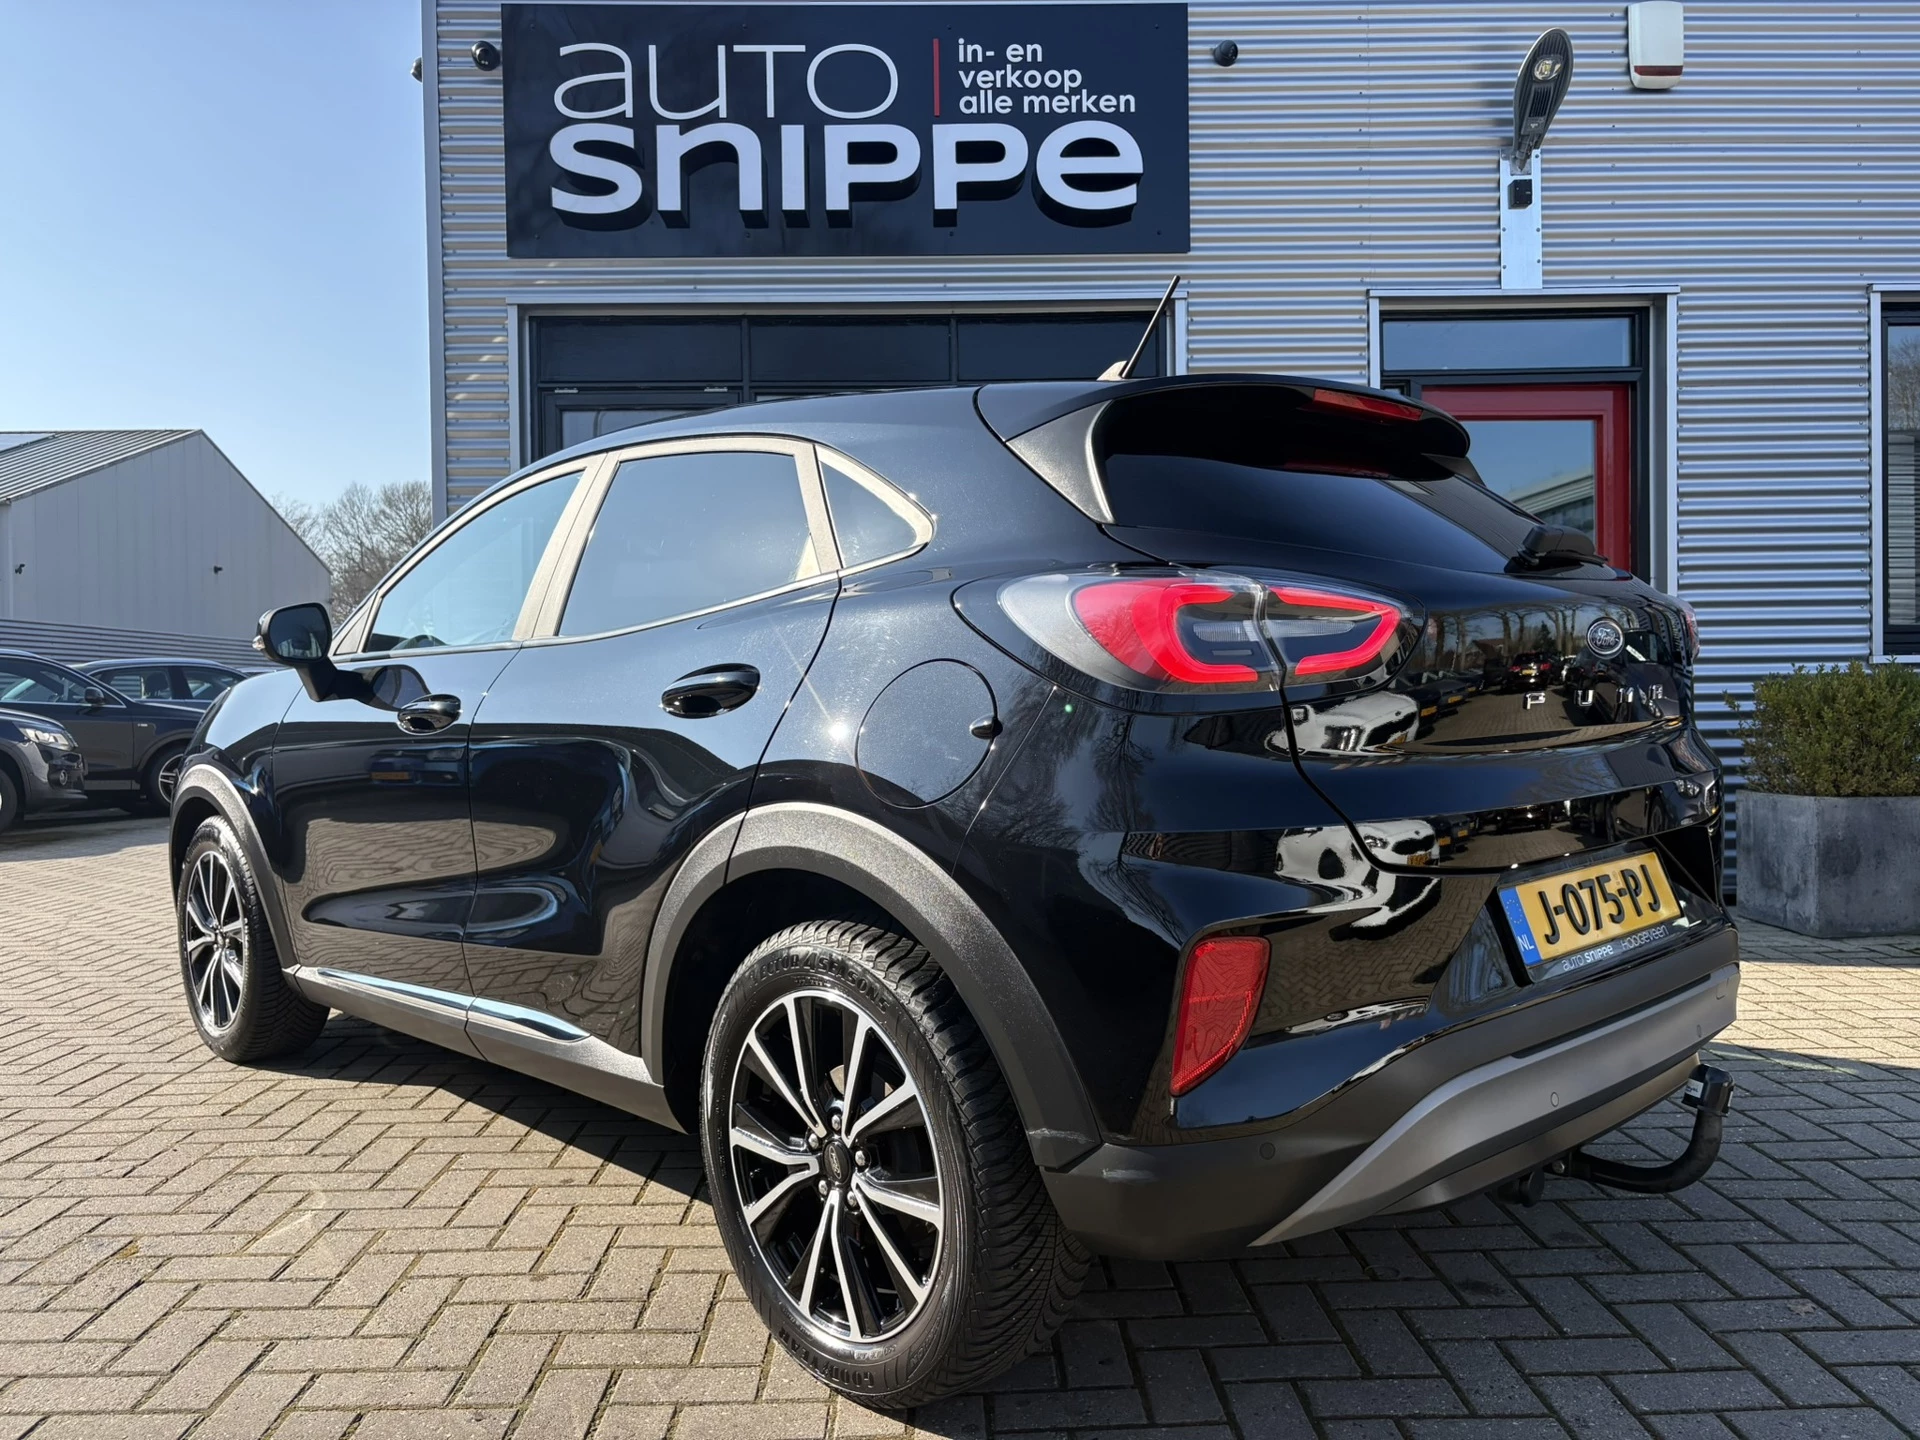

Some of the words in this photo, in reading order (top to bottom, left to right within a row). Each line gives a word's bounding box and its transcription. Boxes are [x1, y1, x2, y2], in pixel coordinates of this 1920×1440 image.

[957, 37, 996, 63] in-
[1005, 43, 1043, 63] en
[957, 64, 1083, 94] verkoop
[958, 89, 1014, 115] alle
[1023, 88, 1136, 114] merken
[1537, 863, 1662, 946] J-075-PJ
[1517, 933, 1535, 952] NL
